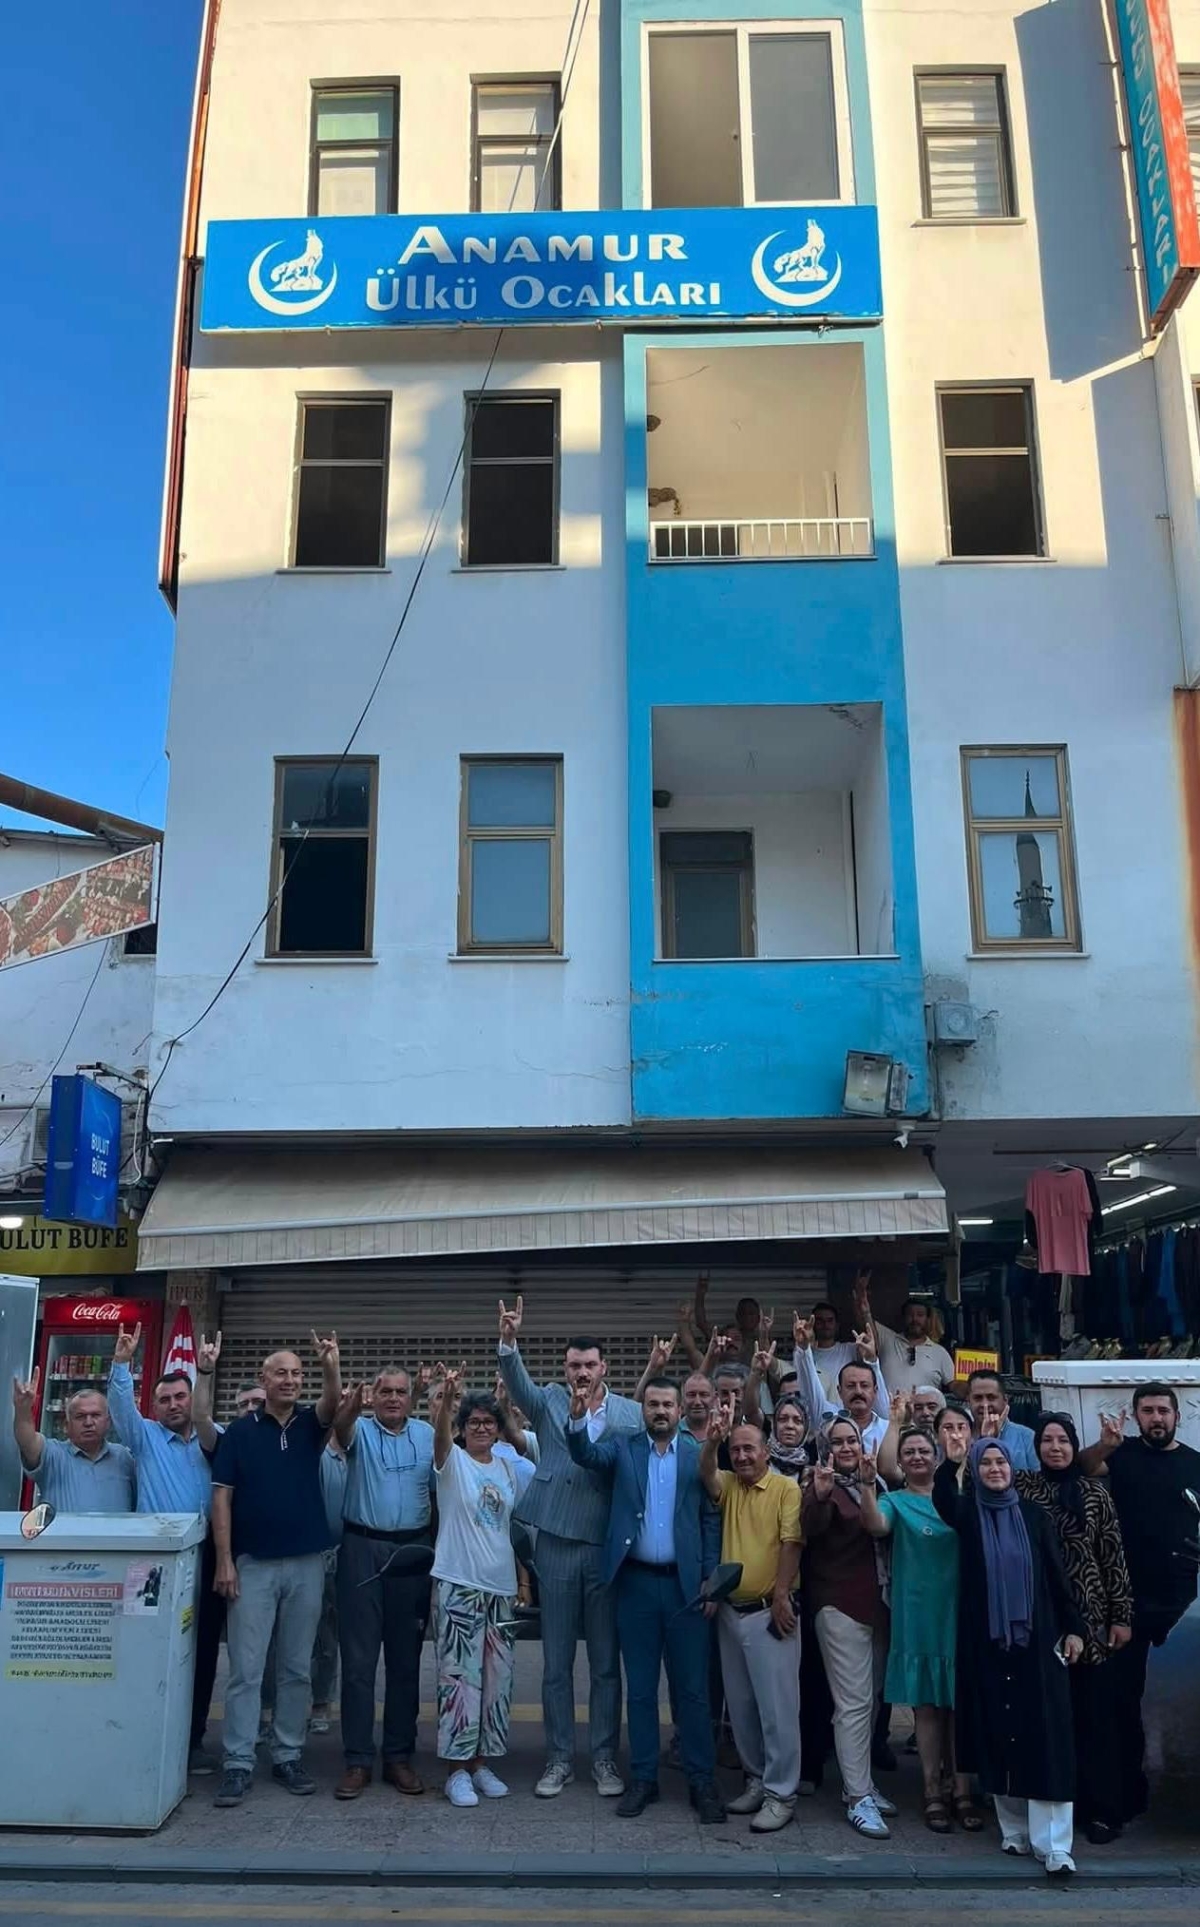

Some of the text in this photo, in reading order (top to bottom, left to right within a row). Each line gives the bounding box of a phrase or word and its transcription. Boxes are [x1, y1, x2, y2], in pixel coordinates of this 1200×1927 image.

[398, 226, 688, 265] ANAMUR
[91, 1132, 110, 1155] BULUT
[91, 1155, 107, 1178] BÜFE
